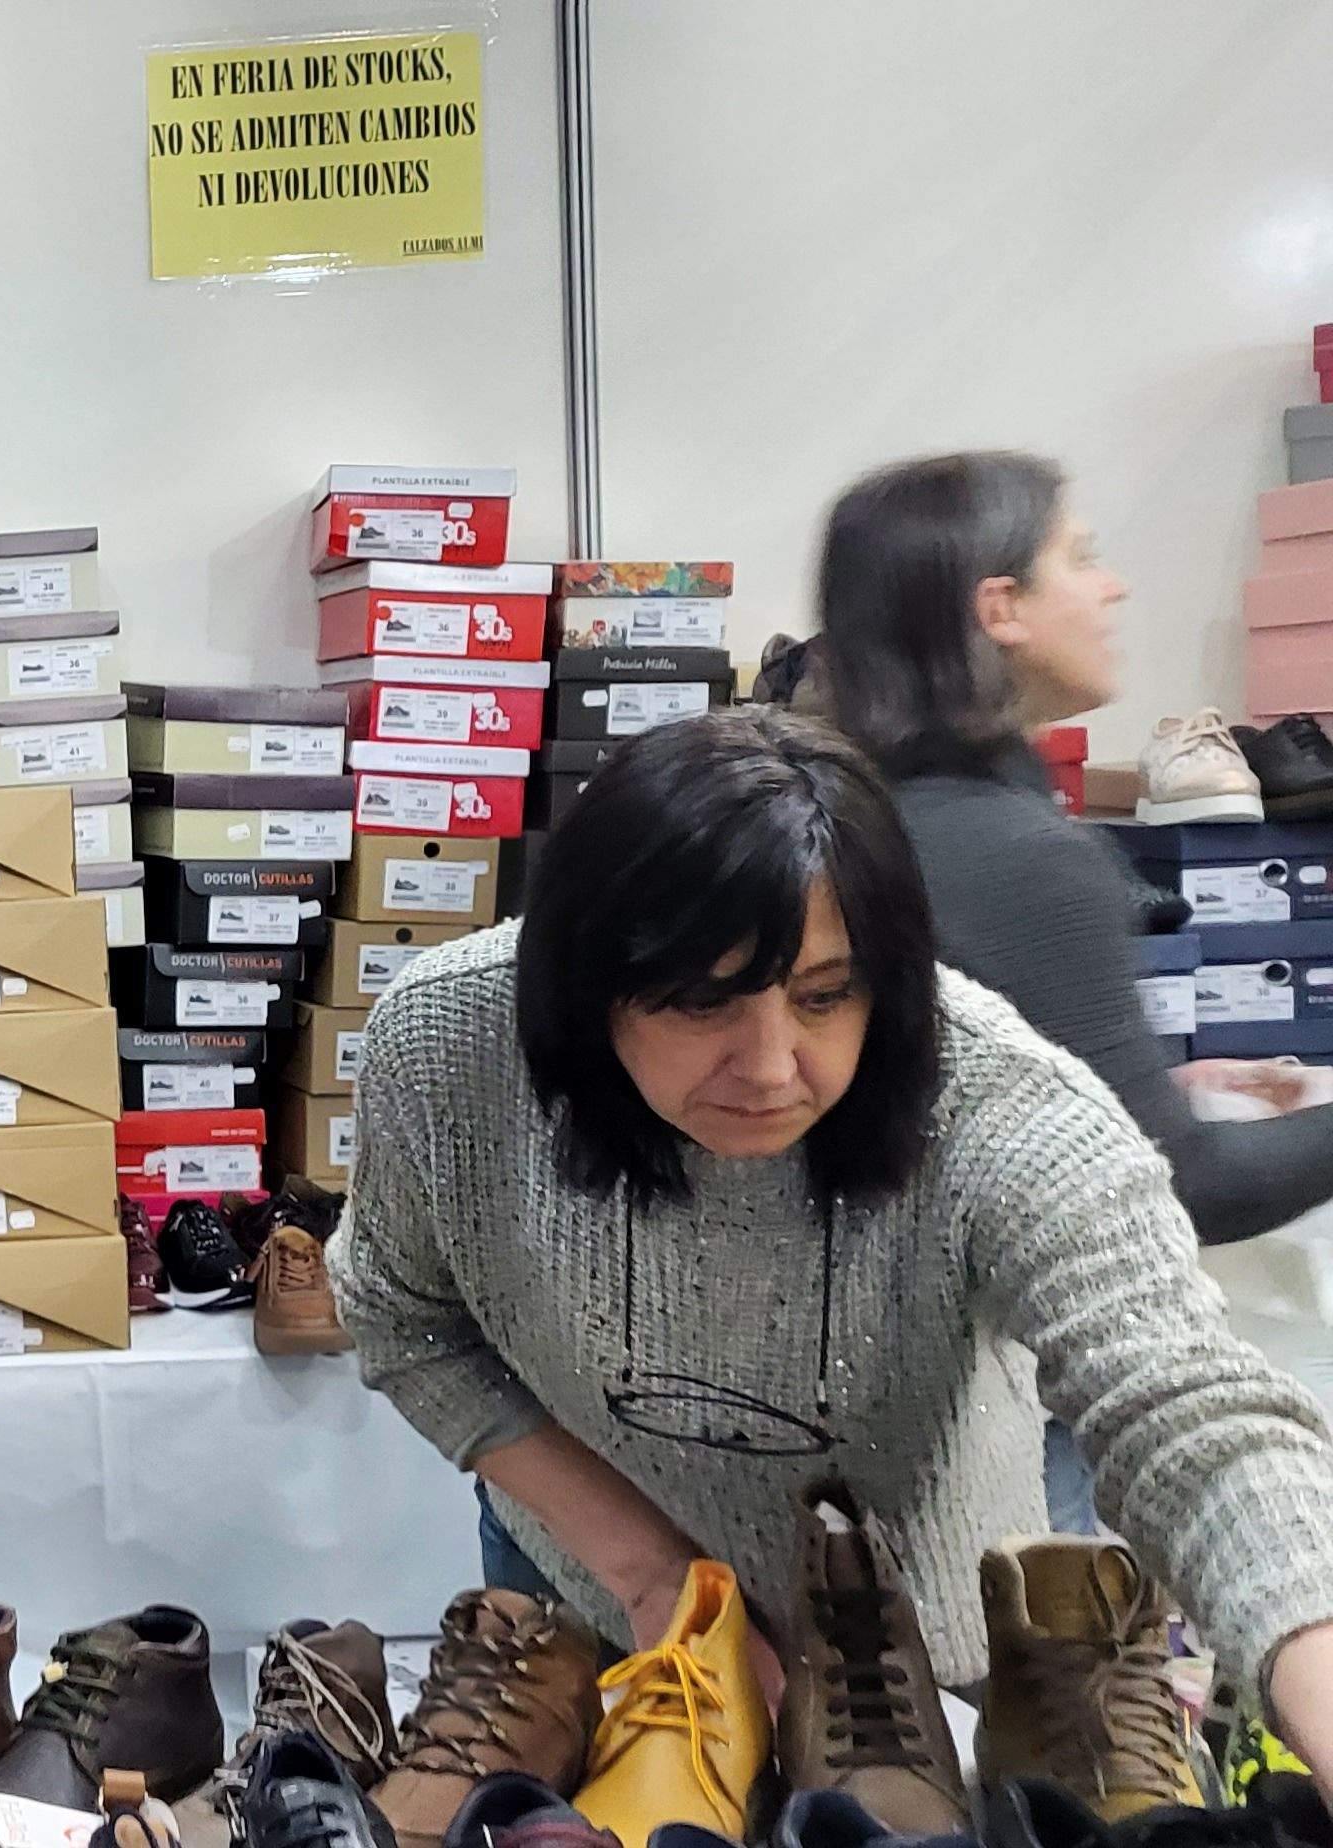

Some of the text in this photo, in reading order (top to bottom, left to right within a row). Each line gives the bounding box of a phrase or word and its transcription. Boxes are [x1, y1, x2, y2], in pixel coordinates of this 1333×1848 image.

[171, 46, 452, 99] EN FERIA DE STOCKS,
[151, 101, 476, 157] NO SE ADMITEN CAMBIOS
[198, 158, 429, 208] NI DEVOLUCIONES
[403, 237, 454, 253] CALZADOS
[372, 477, 420, 485] PLANTILLA
[203, 872, 314, 885] DOCTOR CUTILLAS
[171, 955, 282, 969] DOCTOR CUTILLAS
[134, 1033, 246, 1047] DOCTOR CUTILLAS
